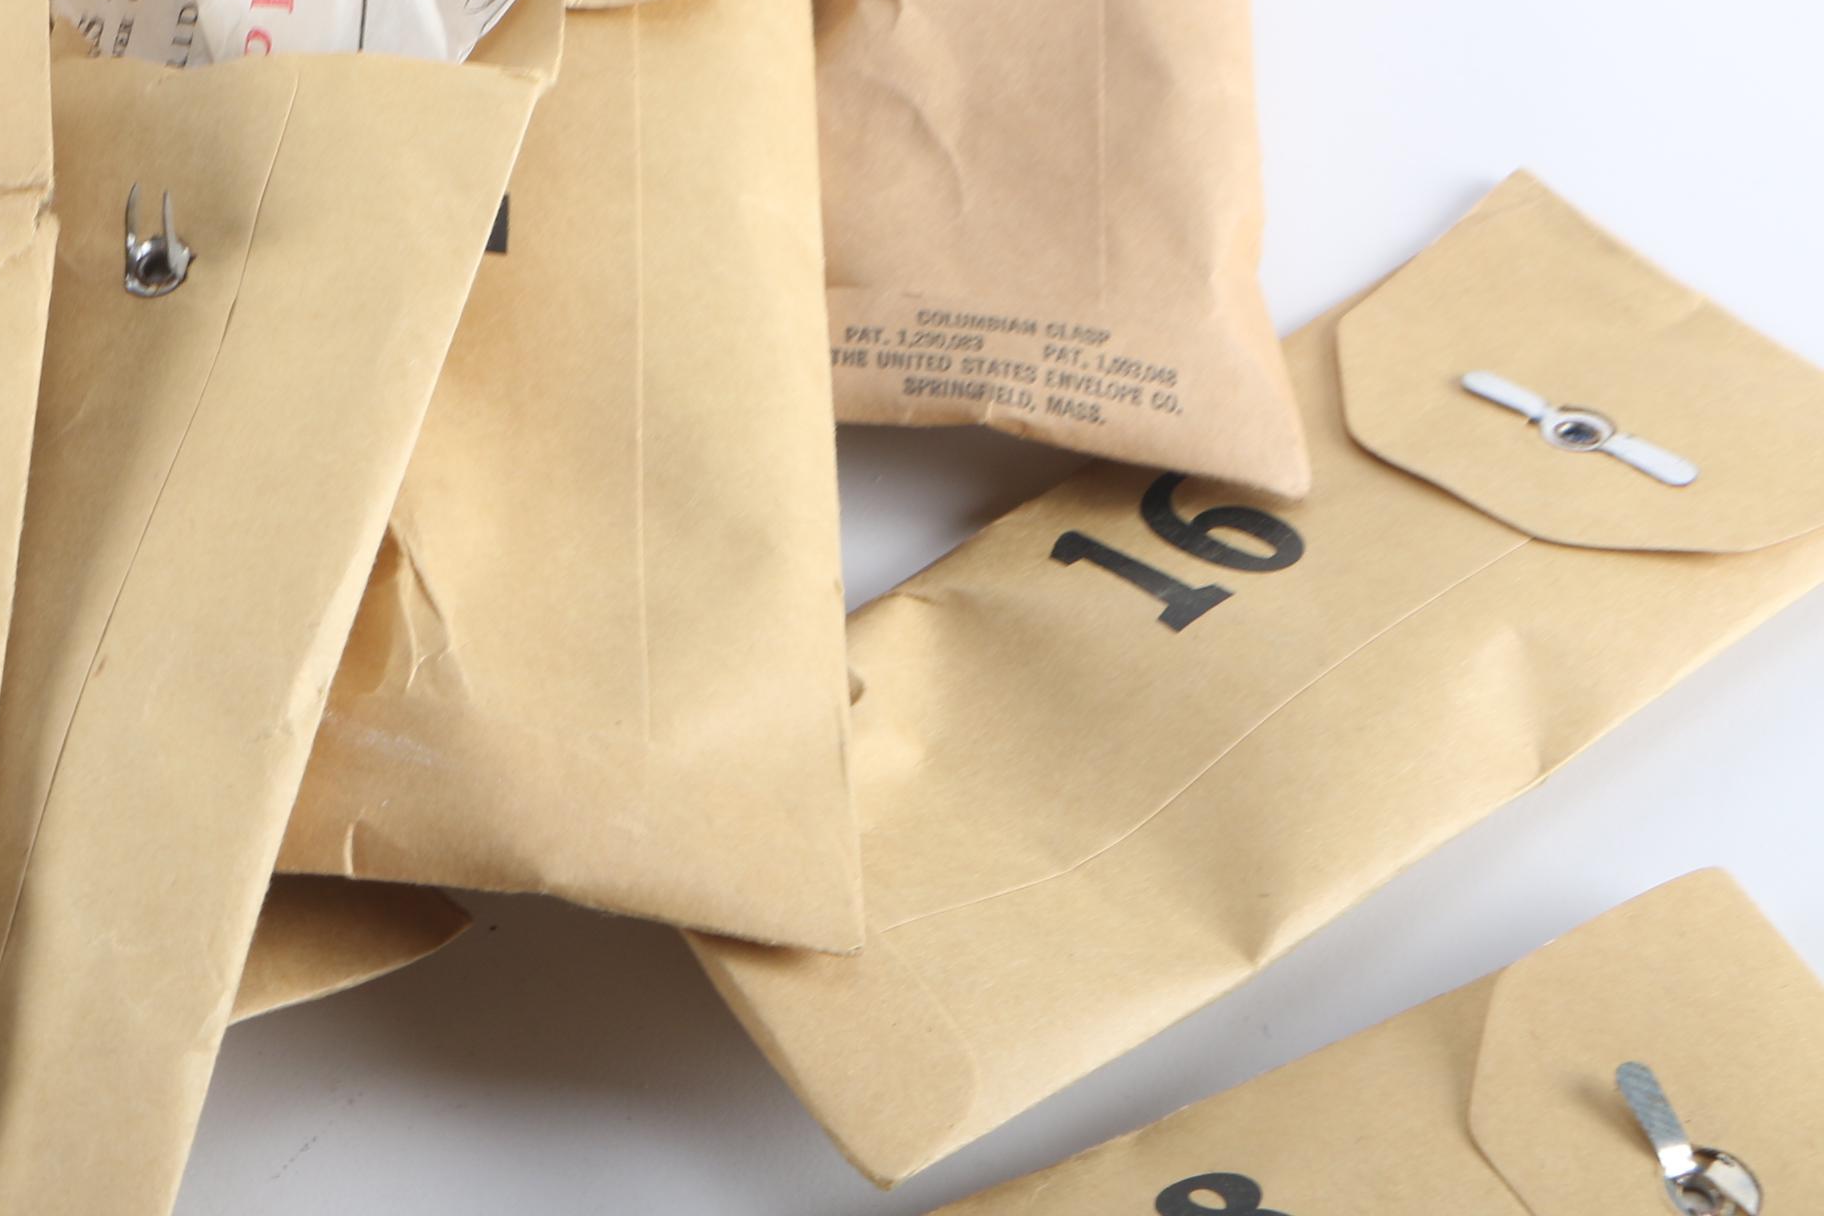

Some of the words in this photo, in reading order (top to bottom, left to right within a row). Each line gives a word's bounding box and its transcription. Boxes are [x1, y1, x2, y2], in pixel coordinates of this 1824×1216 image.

[844, 325, 890, 346] PAT.
[916, 309, 1037, 335] COLUMBIAN
[1044, 321, 1111, 346] CLASP
[1042, 343, 1090, 370] PAT.
[831, 348, 868, 368] THE
[877, 350, 953, 373] UNITED
[961, 355, 1038, 384] STATES
[1044, 368, 1144, 407] ENVELOPE
[1151, 389, 1184, 416] CO.
[1050, 470, 1304, 634] 16
